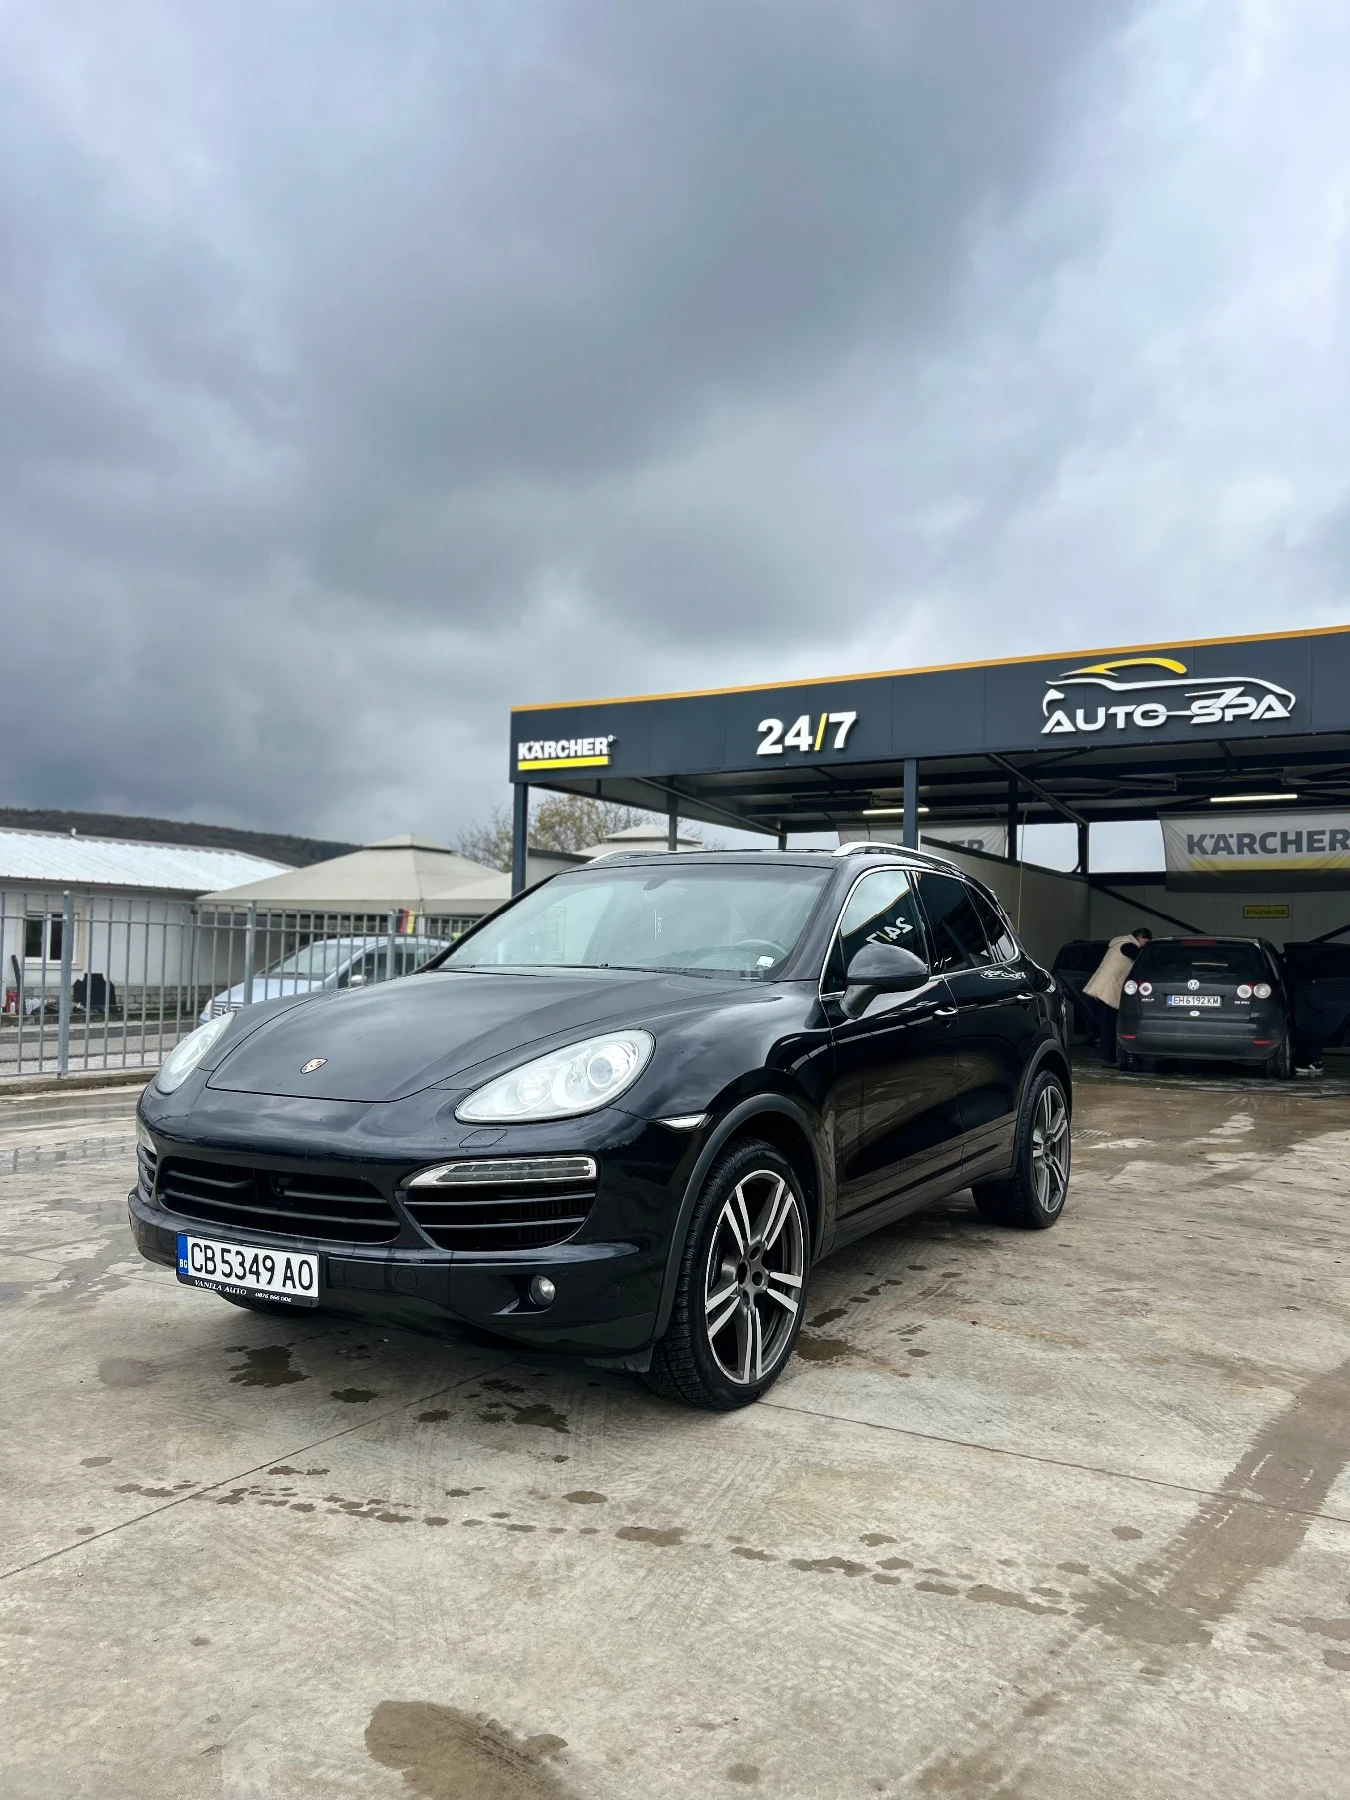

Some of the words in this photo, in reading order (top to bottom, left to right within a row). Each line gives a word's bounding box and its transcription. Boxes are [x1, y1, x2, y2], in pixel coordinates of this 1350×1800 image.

[1041, 703, 1167, 734] AUTO
[1185, 687, 1291, 724] SPA
[756, 711, 857, 755] 24/7
[1187, 829, 1350, 855] KÄRCHER
[179, 1258, 188, 1269] BG
[223, 1286, 247, 1295] AUTO
